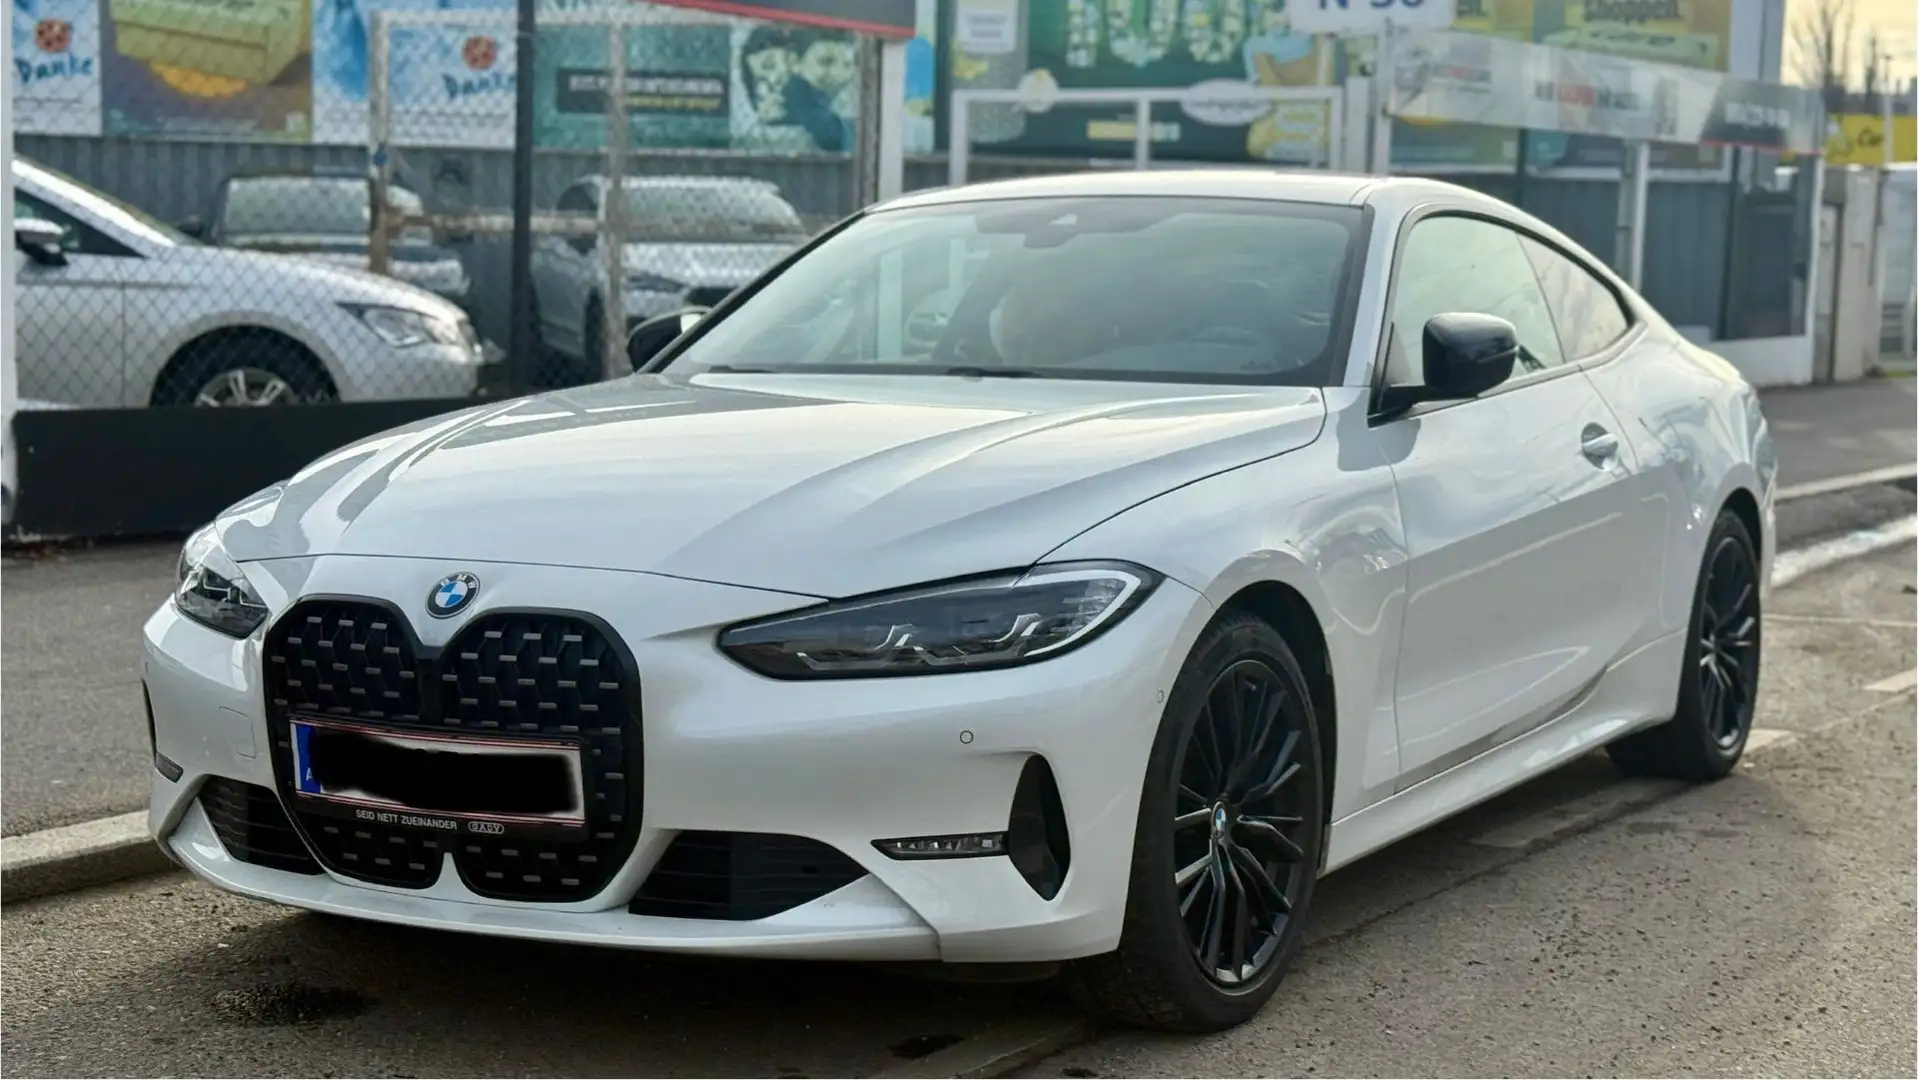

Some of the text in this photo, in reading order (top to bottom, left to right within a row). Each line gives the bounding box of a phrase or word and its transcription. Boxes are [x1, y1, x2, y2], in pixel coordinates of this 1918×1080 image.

[355, 809, 458, 830] SEID NETT ZUEINANDER
